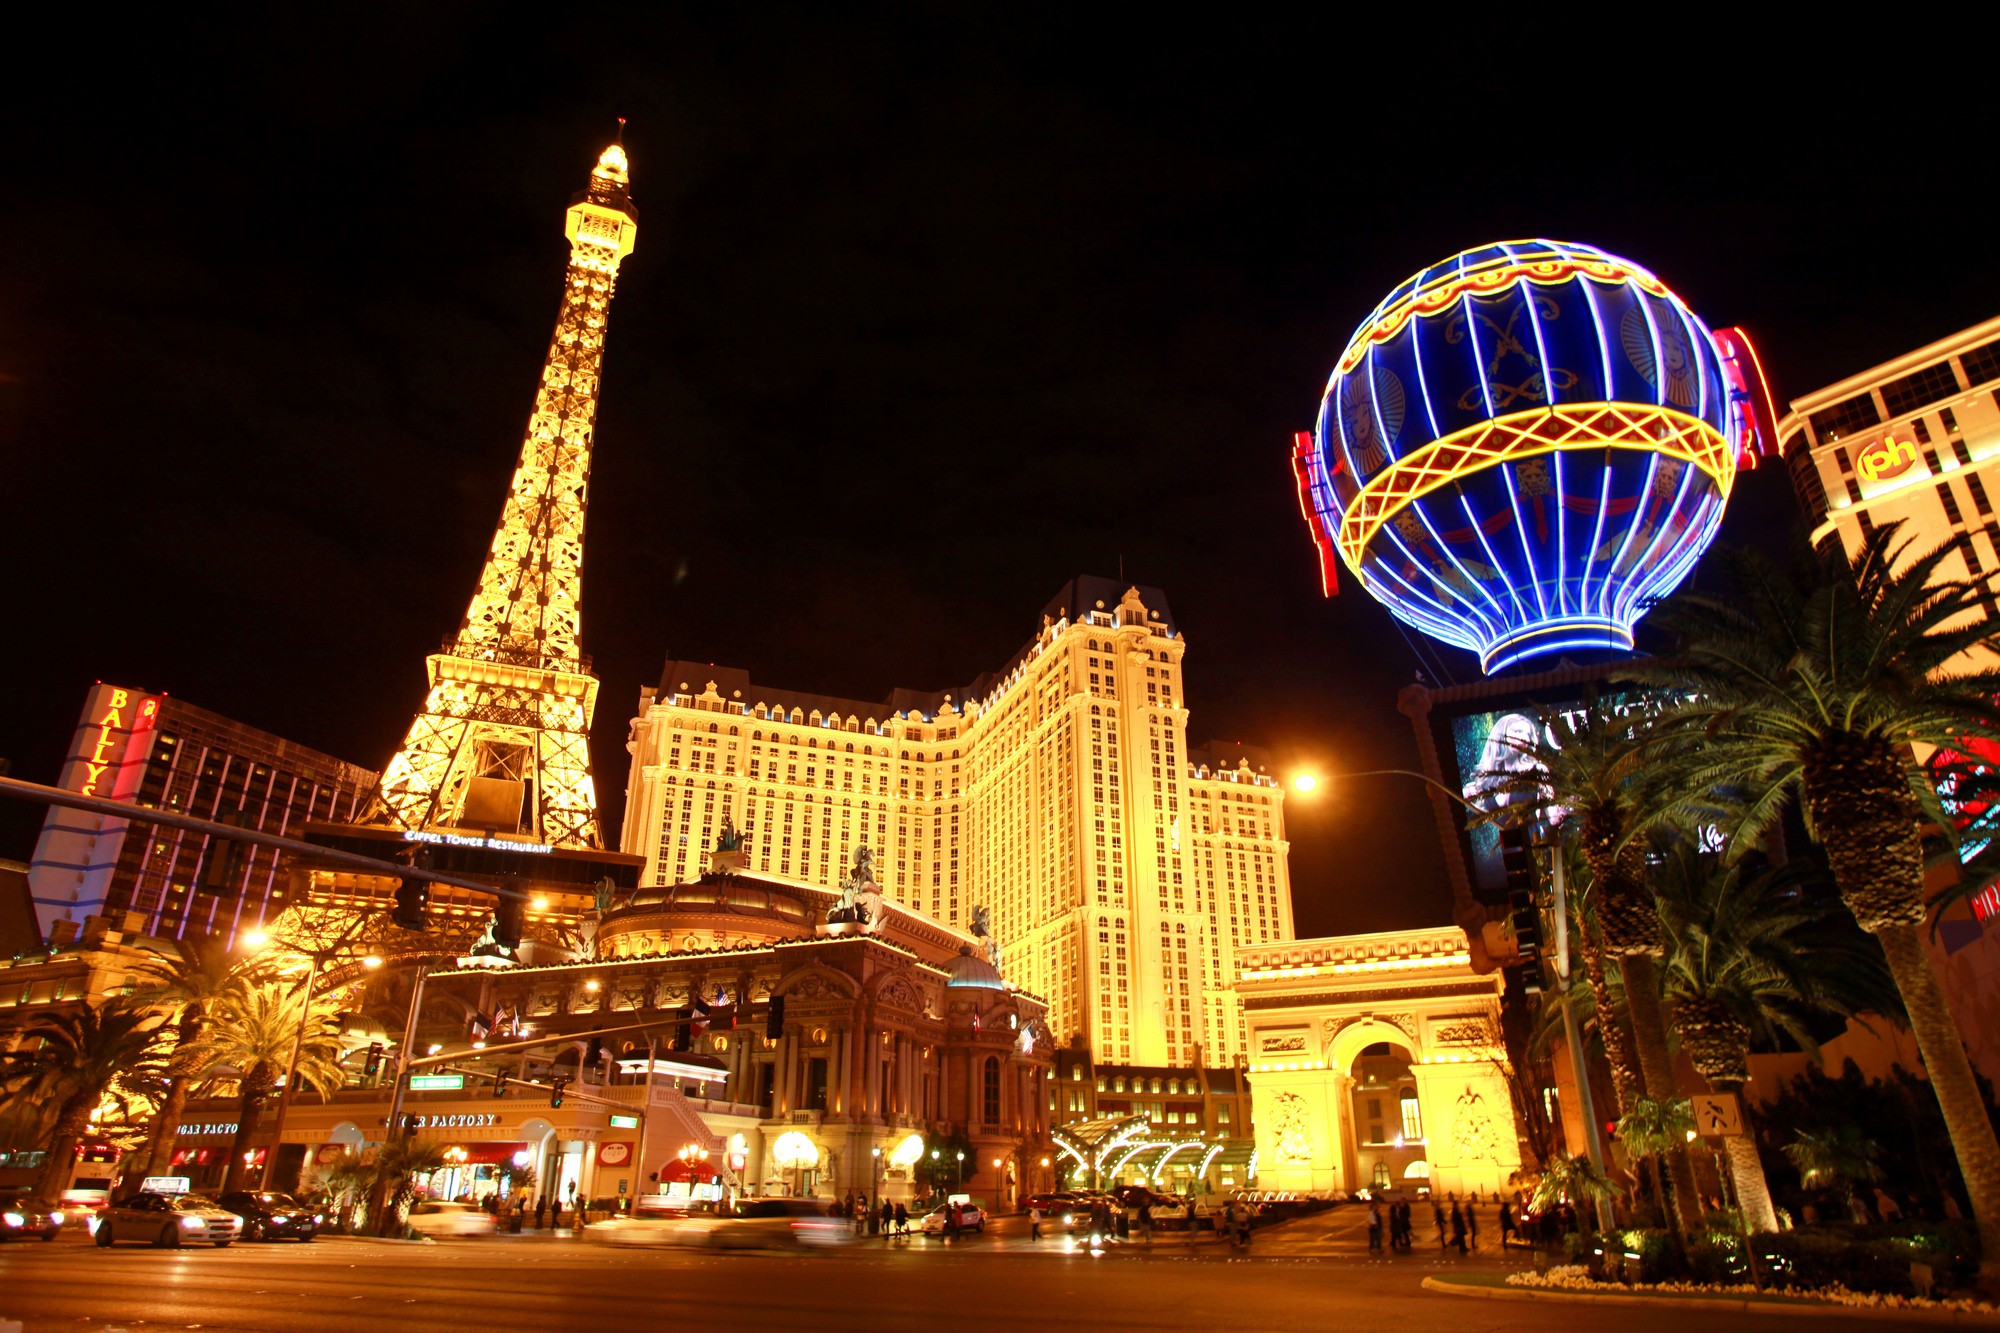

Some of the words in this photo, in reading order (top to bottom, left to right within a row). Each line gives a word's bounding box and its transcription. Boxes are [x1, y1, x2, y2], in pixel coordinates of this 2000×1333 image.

[404, 831, 442, 844] EIFFEL
[445, 834, 484, 847] TOWER
[488, 838, 553, 854] RESTAURANT
[430, 1115, 495, 1127] FACTORY
[177, 1124, 201, 1135] GAR
